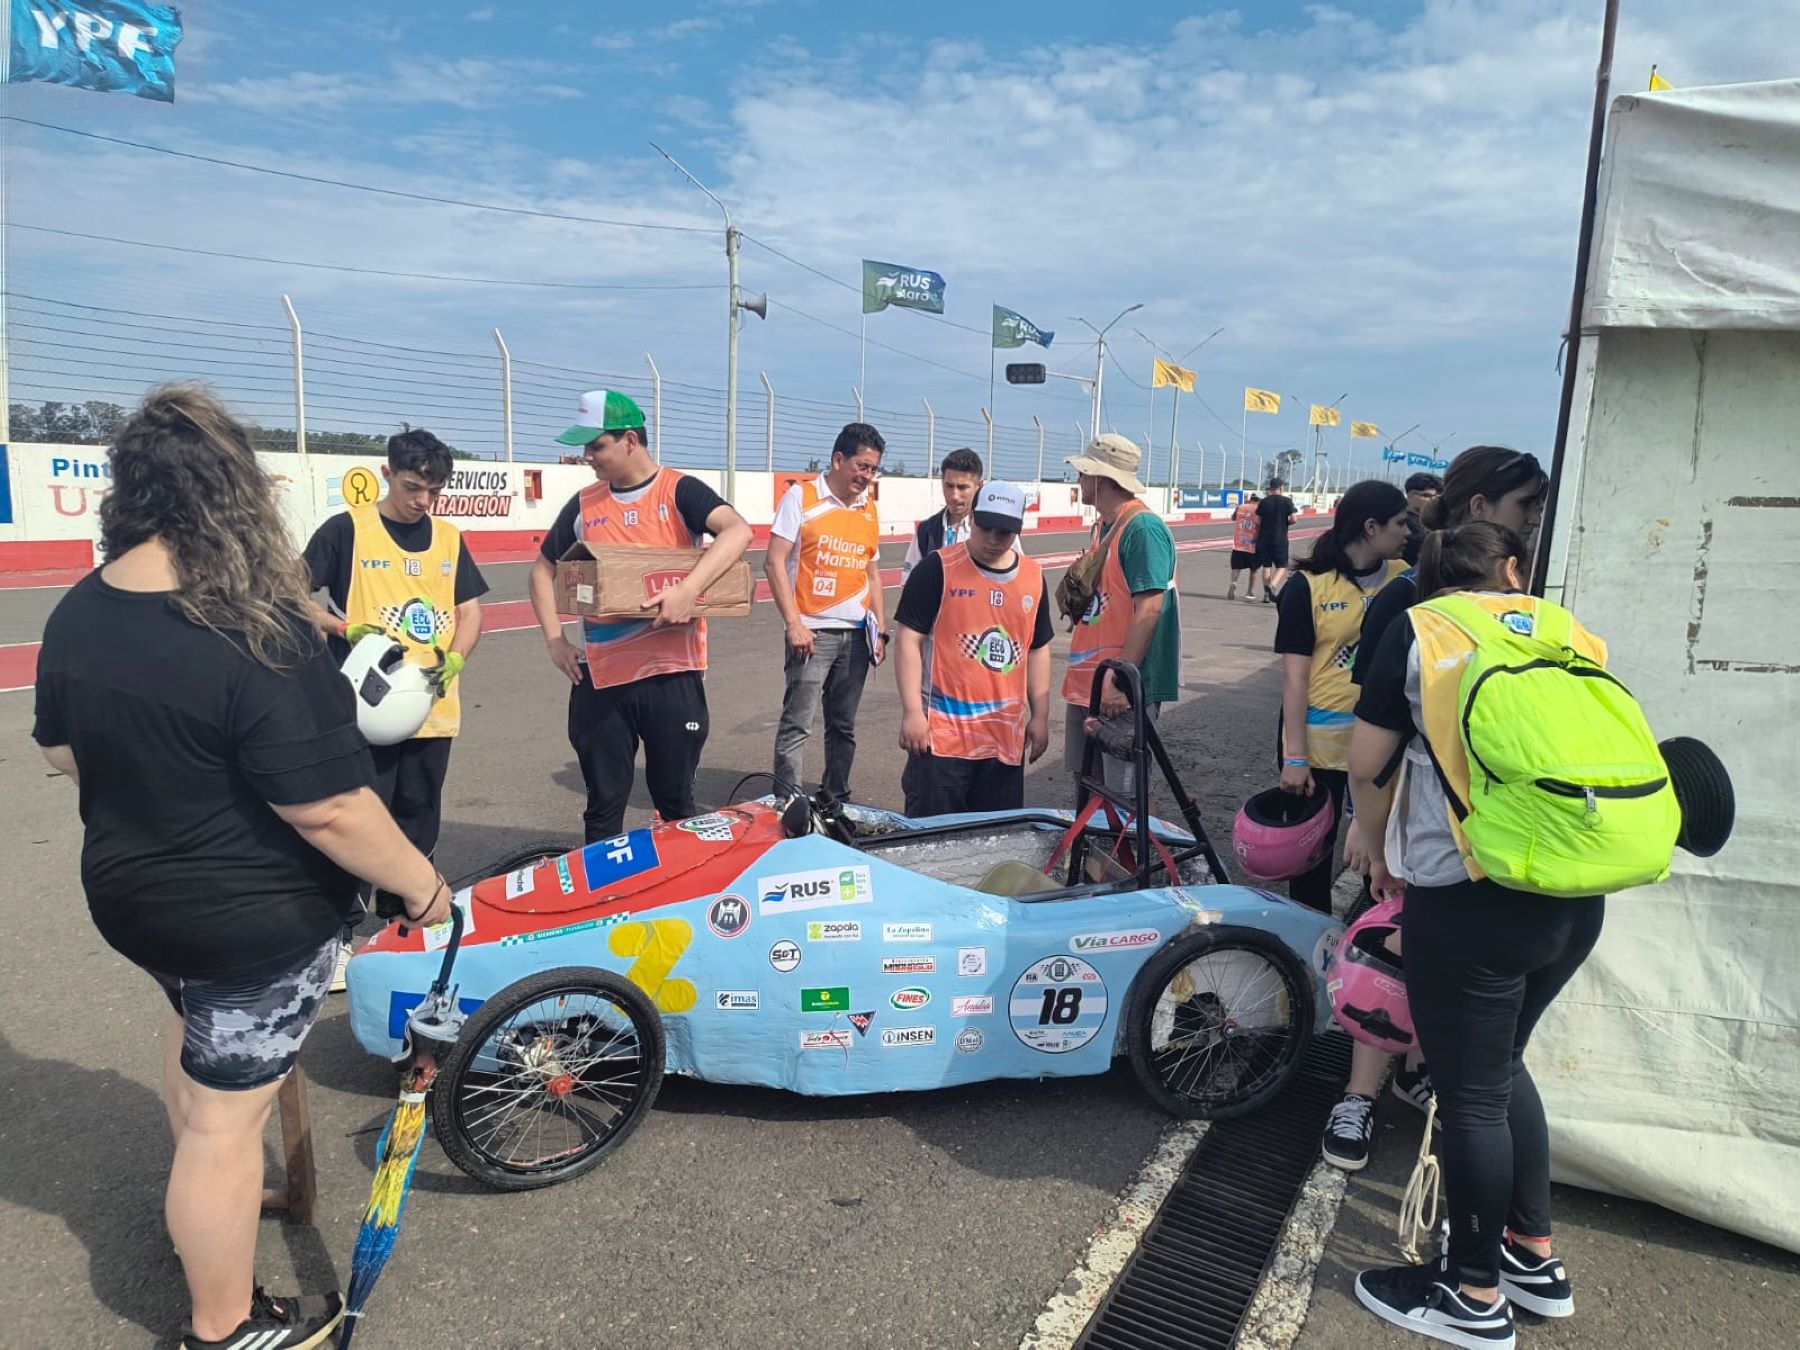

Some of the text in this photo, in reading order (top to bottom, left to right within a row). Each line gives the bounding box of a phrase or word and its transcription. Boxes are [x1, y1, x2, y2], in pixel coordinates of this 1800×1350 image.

[31, 9, 157, 61] YPF
[900, 274, 931, 290] RUS
[52, 458, 110, 478] Pint
[585, 516, 609, 529] YPF
[623, 510, 640, 527] 18
[817, 534, 865, 555] Pitlane
[360, 559, 391, 569] YPF
[403, 557, 422, 577] 18
[815, 580, 834, 593] 04
[949, 588, 976, 598] YPF
[989, 589, 1005, 607] 18
[1320, 602, 1349, 612] YPF
[791, 880, 831, 899] RUS
[1110, 932, 1158, 945] CARGO
[730, 993, 757, 1003] imas
[895, 993, 925, 1004] FINES
[1038, 987, 1082, 1026] 18
[896, 1029, 933, 1042] INSEN
